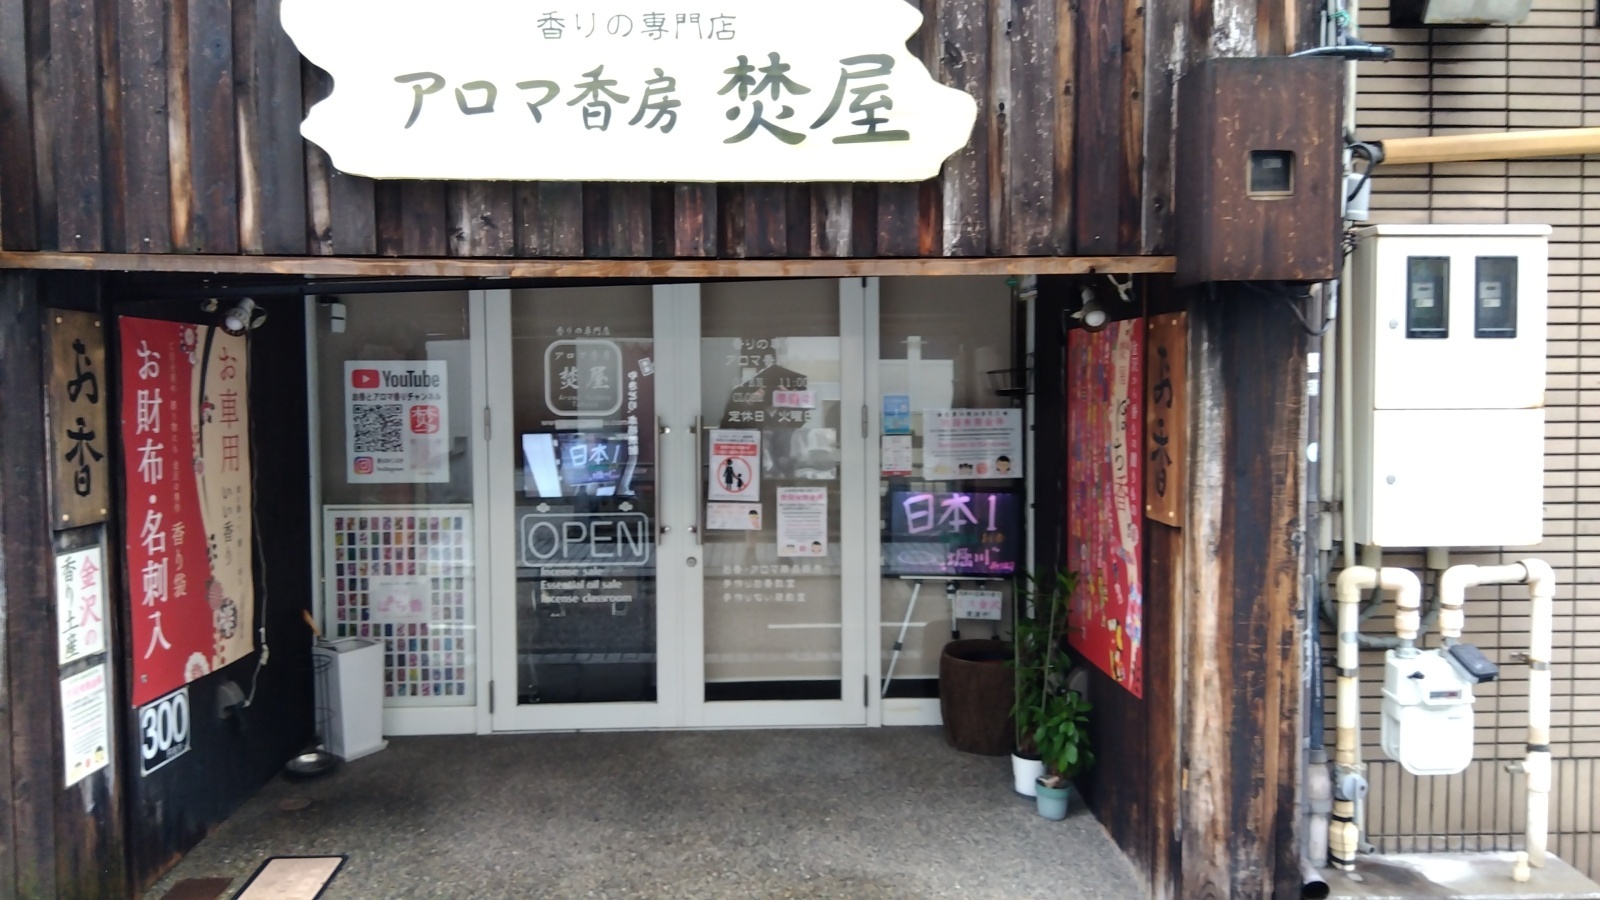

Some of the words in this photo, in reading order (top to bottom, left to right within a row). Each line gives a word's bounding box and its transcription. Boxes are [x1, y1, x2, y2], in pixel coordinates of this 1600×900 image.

[536, 12, 737, 42] 香りの専門店
[394, 64, 681, 134] アロマ香房
[716, 52, 911, 145] 焚屋
[382, 370, 440, 388] YouTube
[65, 338, 103, 497] お香
[218, 346, 240, 473] お車用
[728, 411, 764, 422] 定休日
[528, 520, 643, 559] OPEN
[540, 580, 584, 590] Essential
[586, 580, 600, 589] oil
[602, 579, 623, 589] sale
[142, 693, 188, 759] 300
